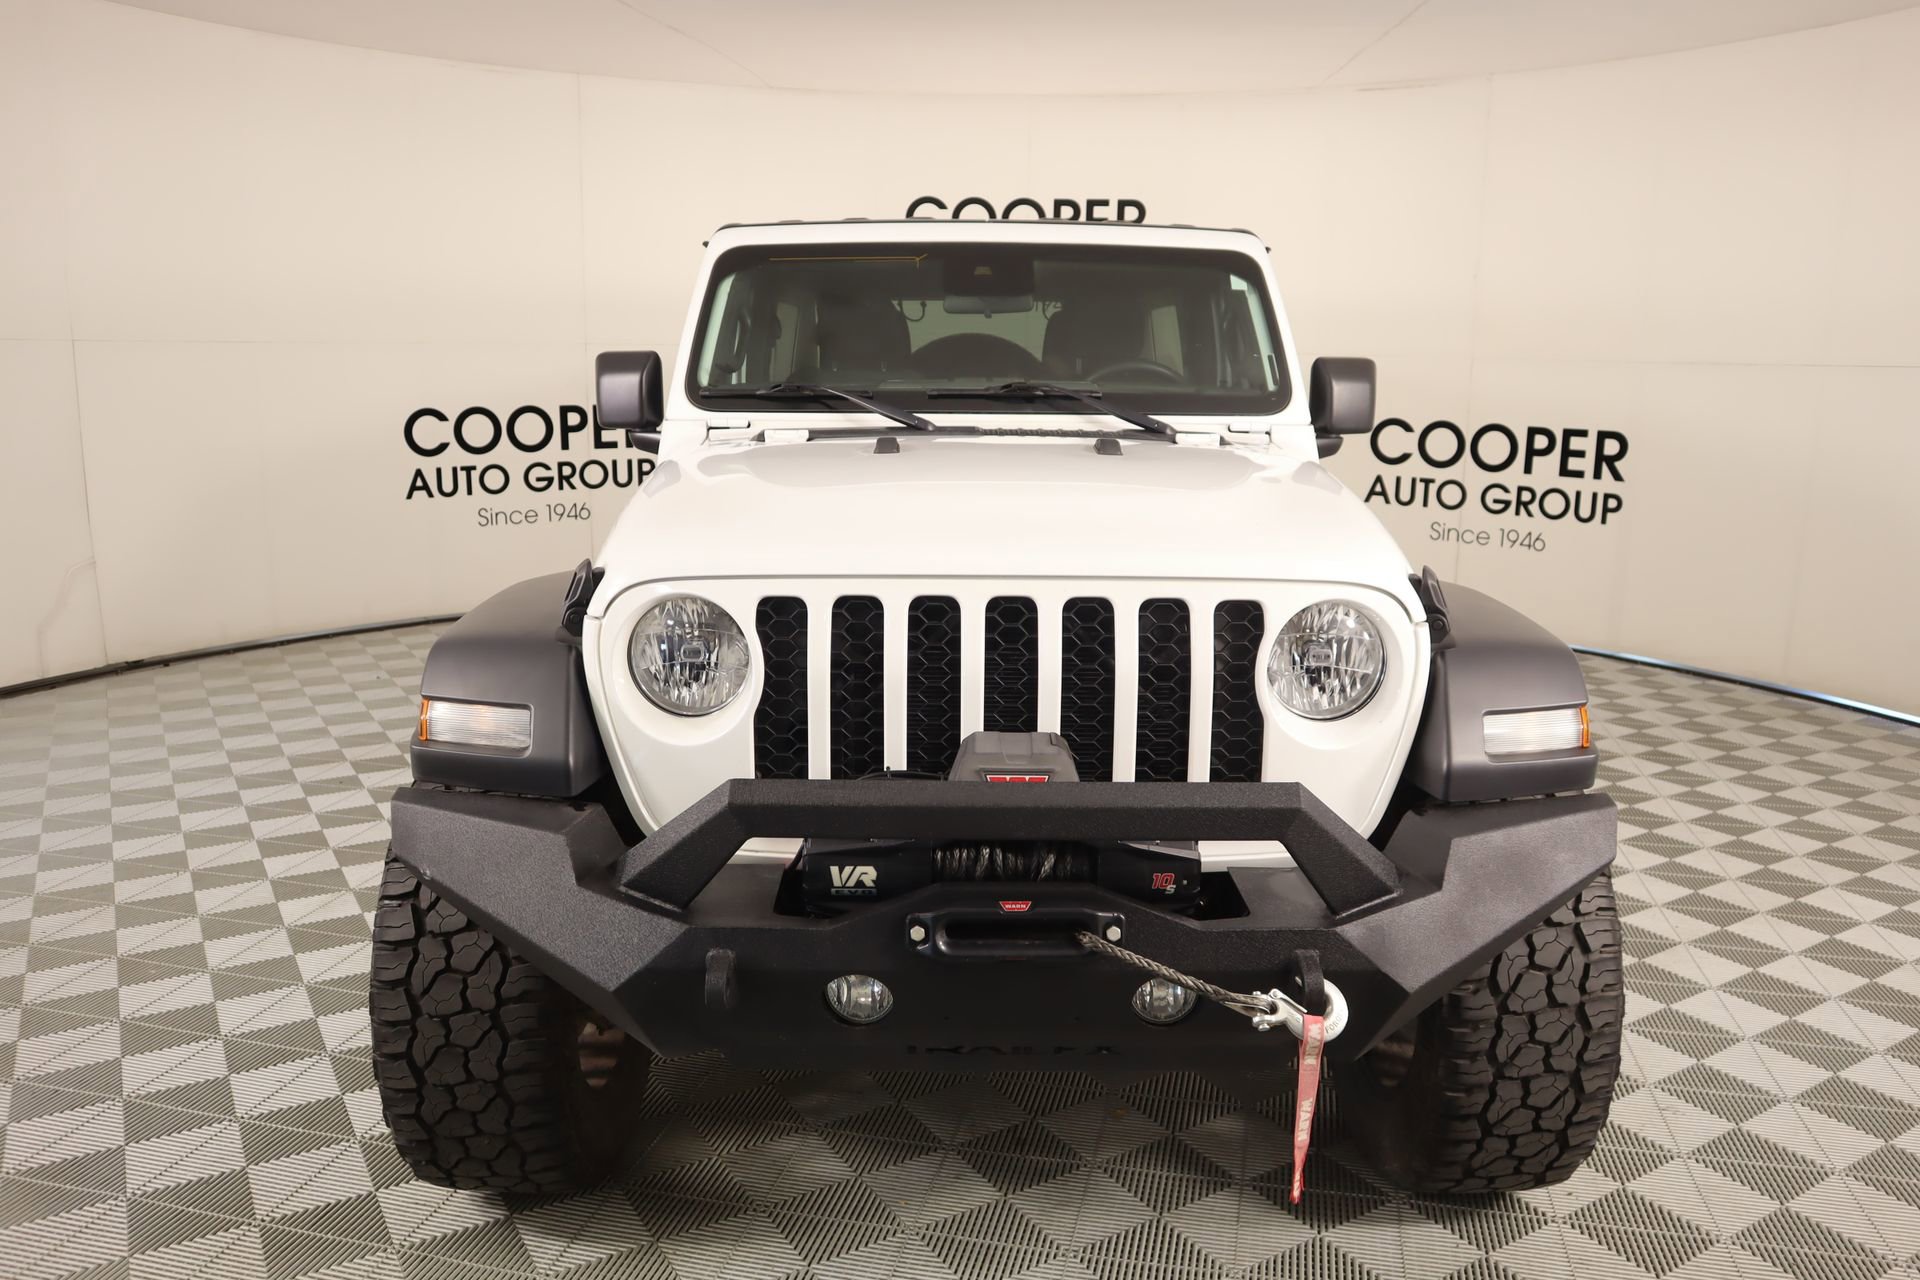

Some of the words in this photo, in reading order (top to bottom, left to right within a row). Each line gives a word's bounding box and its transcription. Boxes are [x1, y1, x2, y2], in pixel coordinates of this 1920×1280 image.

[1370, 417, 1629, 482] COOPER
[405, 463, 510, 500] AUTO
[523, 458, 656, 493] GROUP
[1364, 474, 1467, 510] AUTO
[1480, 482, 1624, 525] GROUP
[477, 506, 539, 527] Since
[546, 502, 592, 523] 1946
[1429, 521, 1491, 546] Since
[1499, 528, 1547, 553] 1946
[829, 866, 878, 888] VR
[1304, 1023, 1321, 1065] WARN
[1298, 1097, 1313, 1141] WARN
